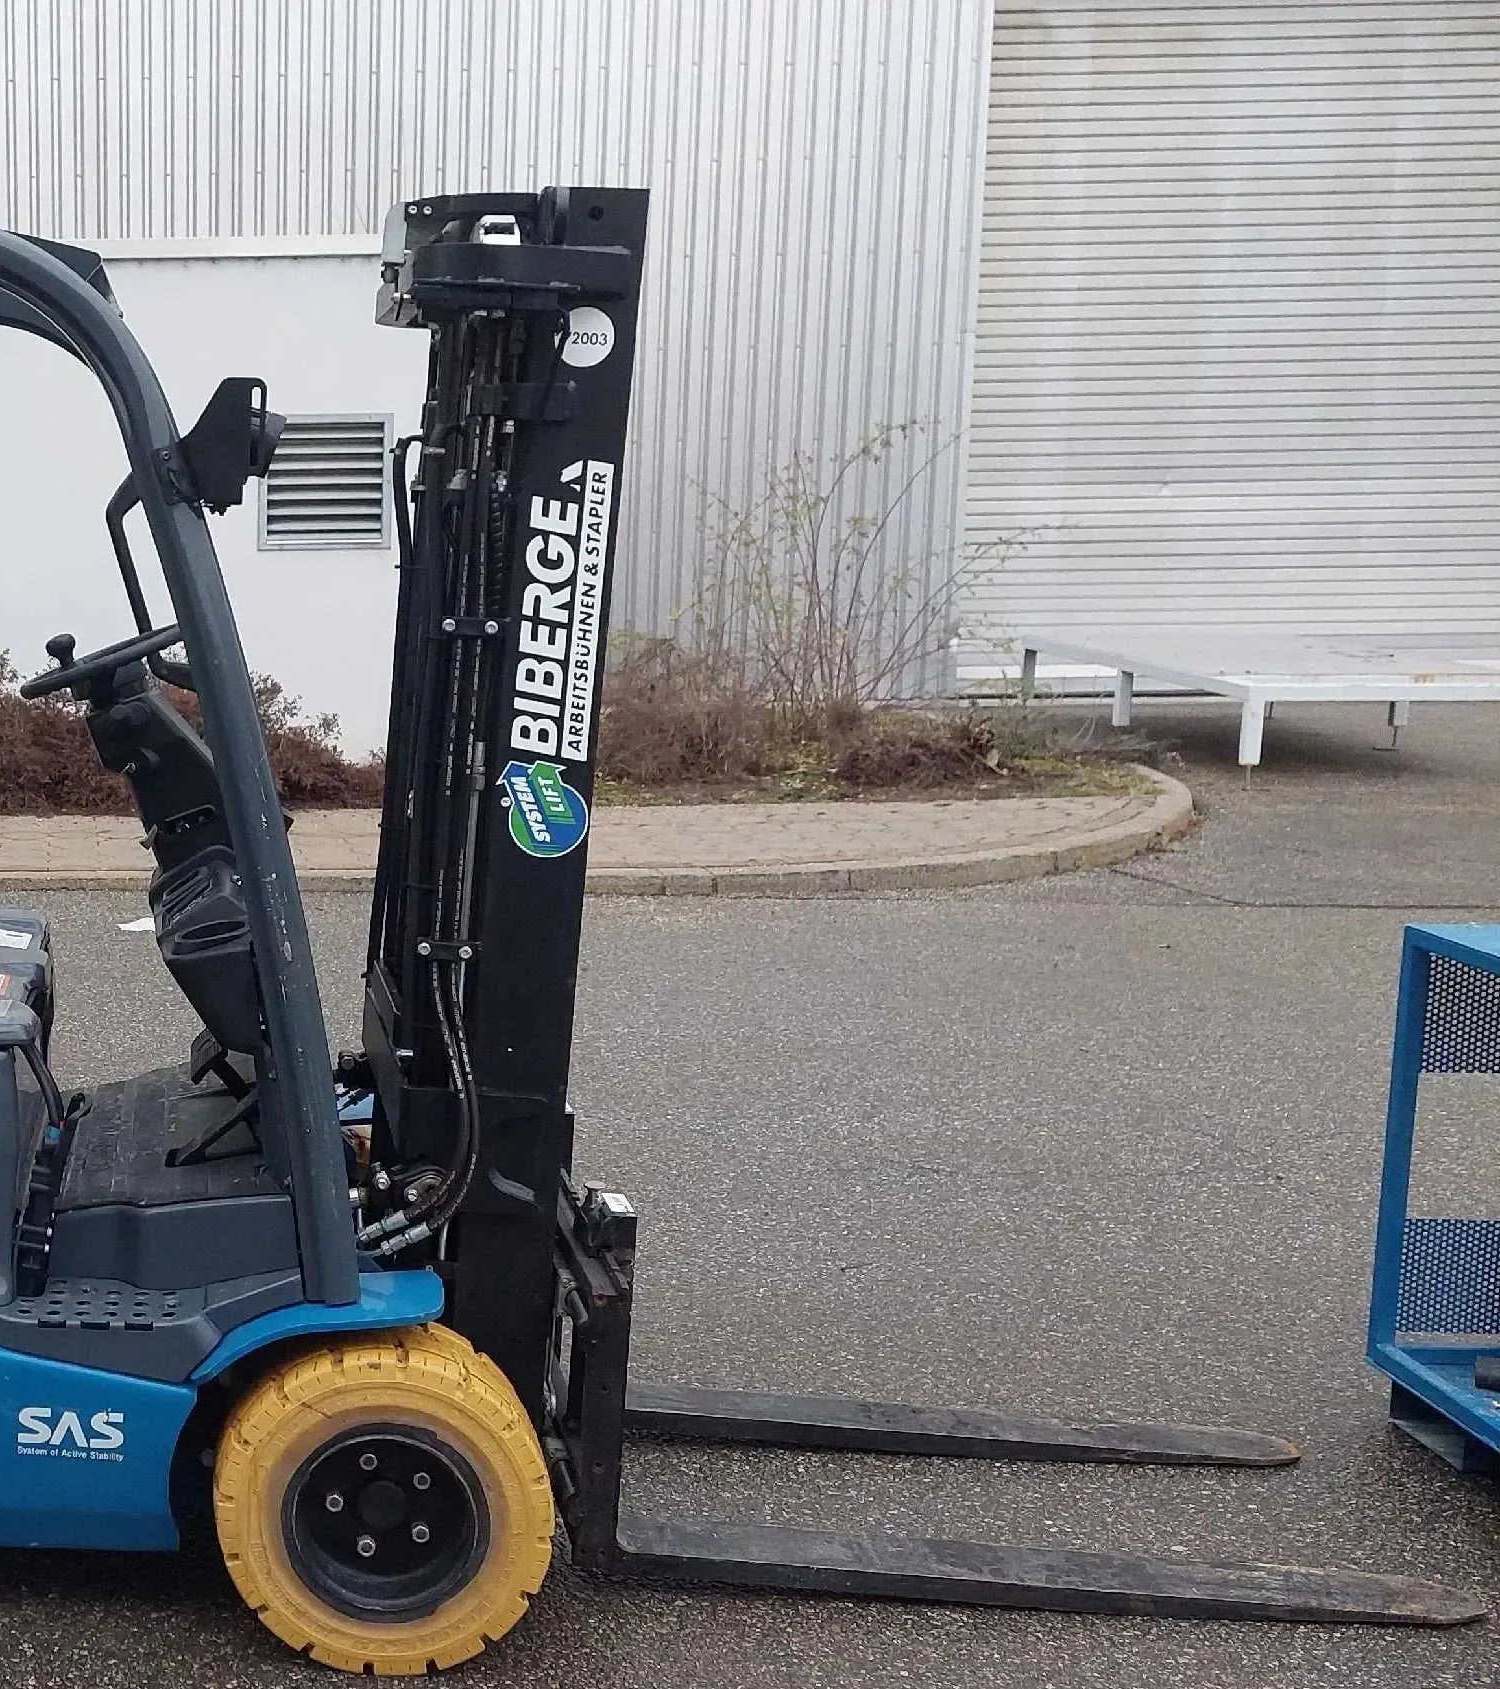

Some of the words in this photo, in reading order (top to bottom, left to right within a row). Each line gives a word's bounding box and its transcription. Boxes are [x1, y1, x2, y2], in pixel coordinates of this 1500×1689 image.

[571, 331, 608, 346] 2003
[585, 472, 608, 557] STAPLER
[583, 562, 598, 577] &
[567, 582, 597, 753] ARBEITSBÜHNEN
[510, 776, 551, 843] SYSTEM
[537, 776, 565, 812] LIFT
[17, 1407, 125, 1449] SAS
[17, 1446, 48, 1456] System
[50, 1448, 59, 1457] of
[61, 1449, 87, 1459] Active
[89, 1451, 124, 1463] Stability
